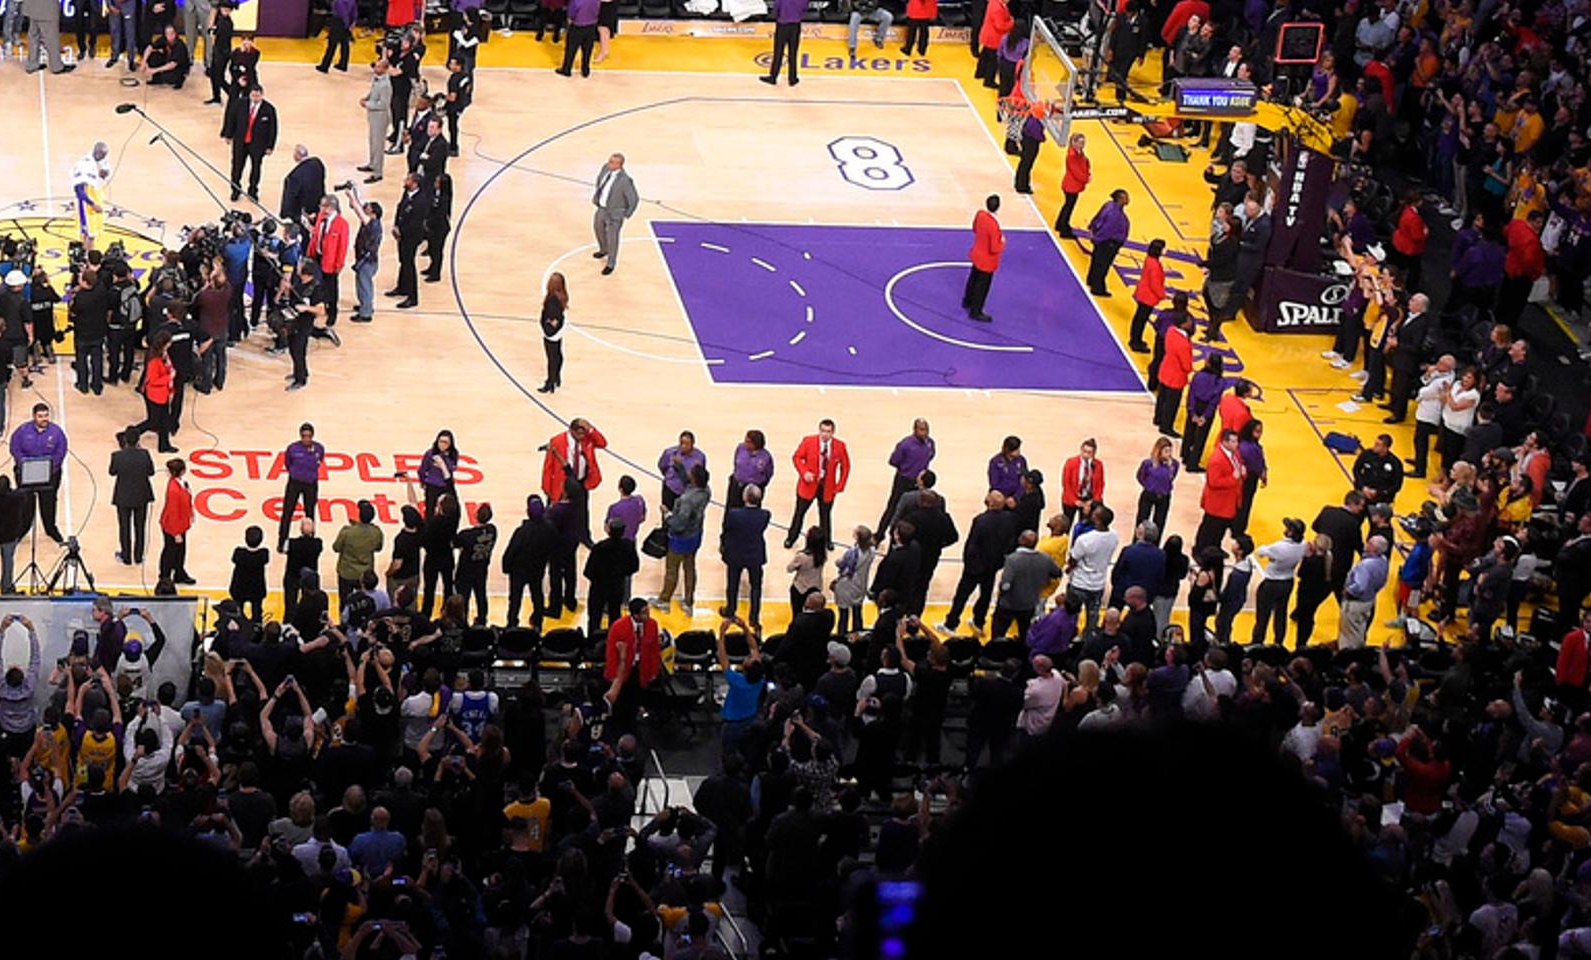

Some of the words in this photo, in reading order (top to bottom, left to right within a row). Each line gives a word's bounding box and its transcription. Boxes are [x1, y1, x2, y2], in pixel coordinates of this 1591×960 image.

[1182, 94, 1211, 106] THANK
[1212, 95, 1229, 107] YOU
[826, 135, 916, 191] 8
